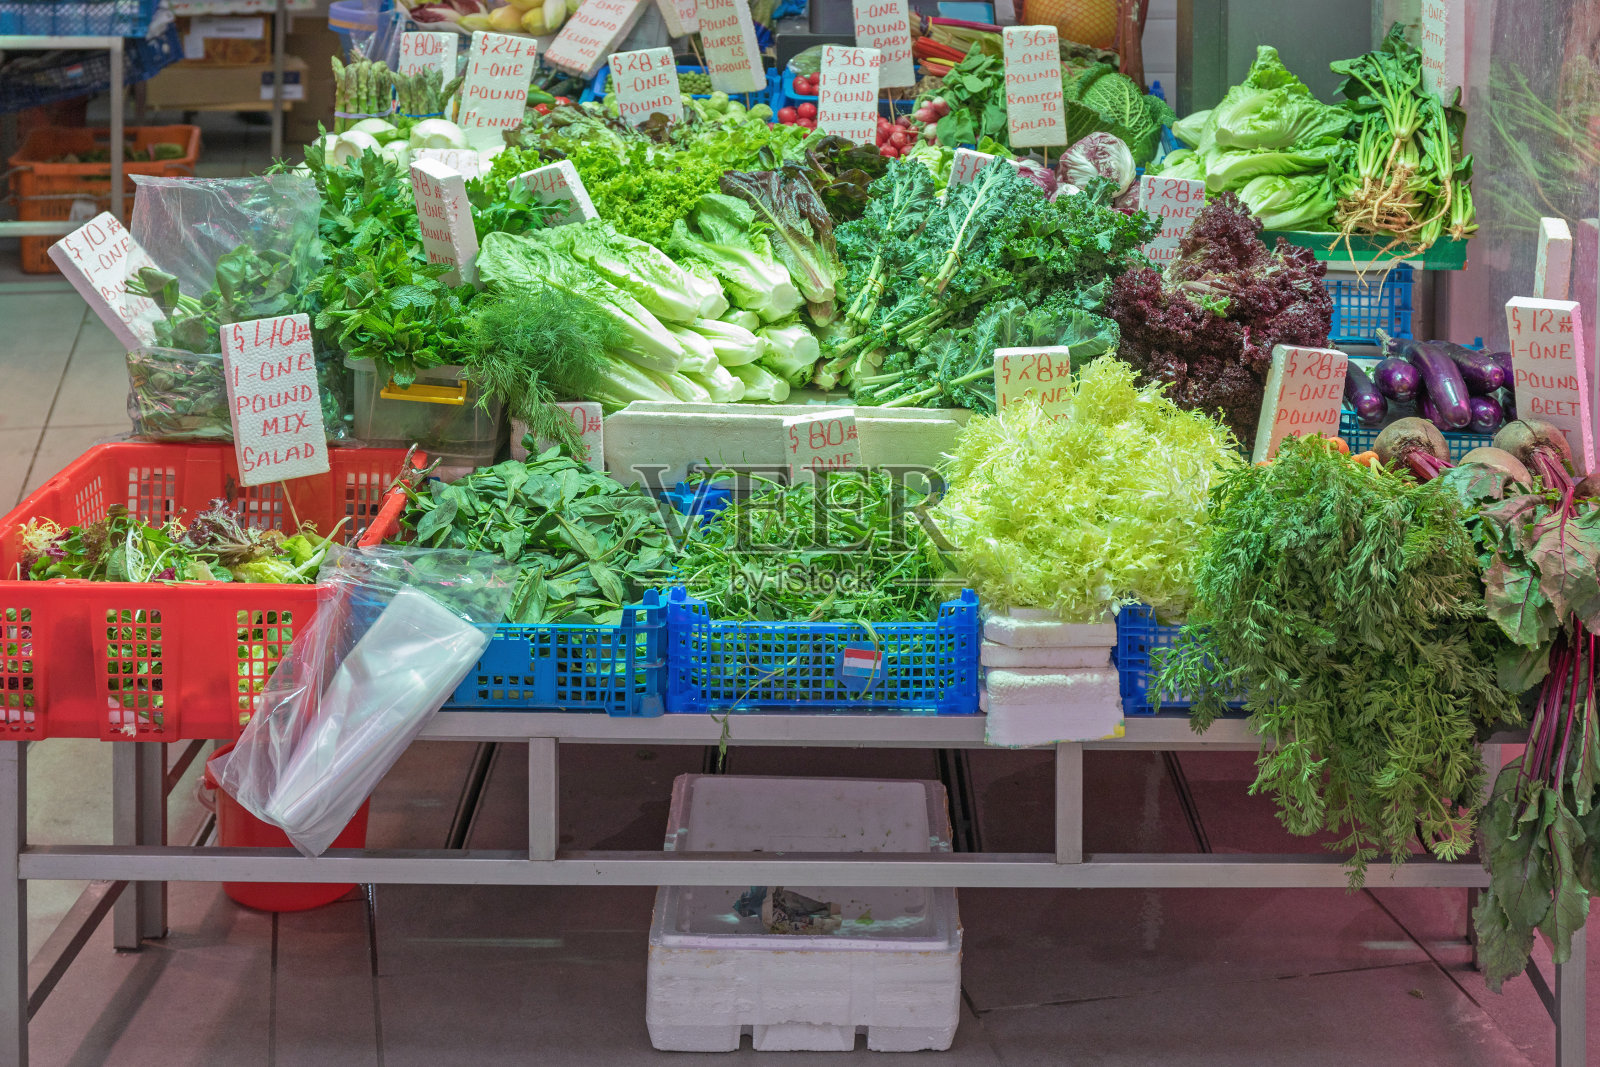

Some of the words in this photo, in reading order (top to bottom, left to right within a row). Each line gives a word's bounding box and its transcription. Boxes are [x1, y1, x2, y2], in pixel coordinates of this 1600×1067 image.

[570, 11, 617, 31] POUND
[698, 15, 739, 31] POUND
[857, 20, 907, 37] POUND
[873, 35, 908, 49] BABY
[579, 48, 597, 59] NO
[880, 50, 911, 64] DISH
[1006, 69, 1059, 86] POUND
[469, 85, 526, 101] POUND
[821, 90, 874, 103] POUND
[619, 95, 673, 117] POUND
[819, 110, 876, 122] BUTTER
[1011, 116, 1056, 134] SALAD
[420, 220, 452, 243] BUNCH
[1515, 368, 1579, 391] POUND
[236, 384, 313, 416] POUND
[1531, 396, 1581, 417] BEET
[261, 410, 312, 437] MIX
[1276, 408, 1338, 426] POUND
[242, 442, 315, 472] SALAD
